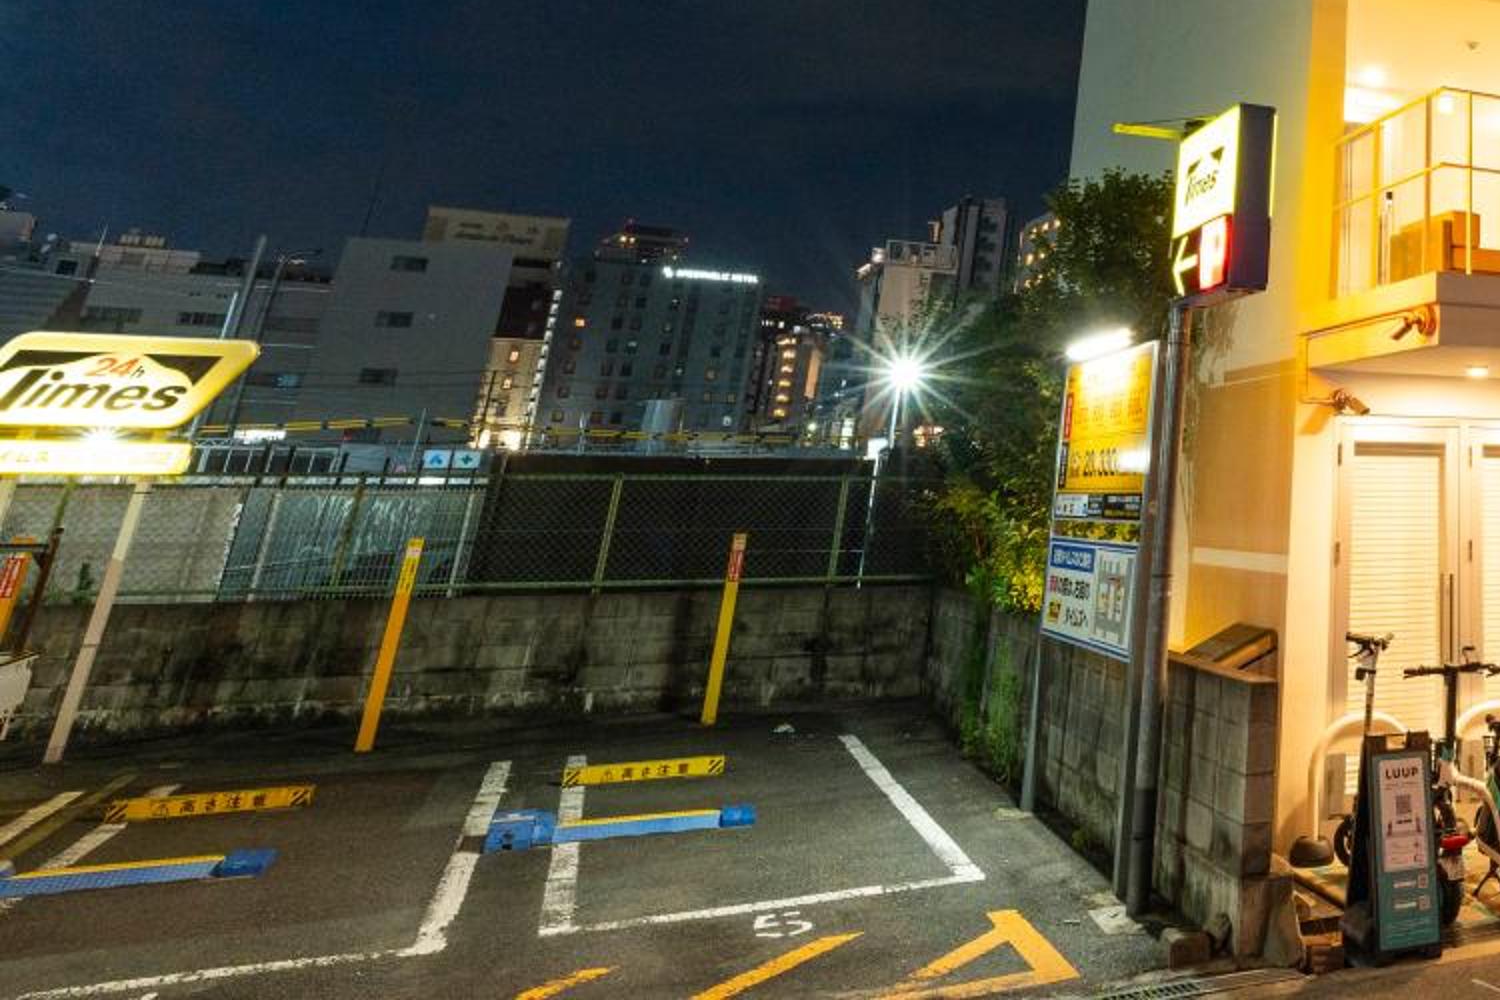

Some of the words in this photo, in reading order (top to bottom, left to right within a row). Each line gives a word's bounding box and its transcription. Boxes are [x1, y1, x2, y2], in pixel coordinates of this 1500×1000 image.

[87, 356, 145, 379] 24h
[0, 368, 188, 412] Times
[1385, 766, 1419, 780] LUUP
